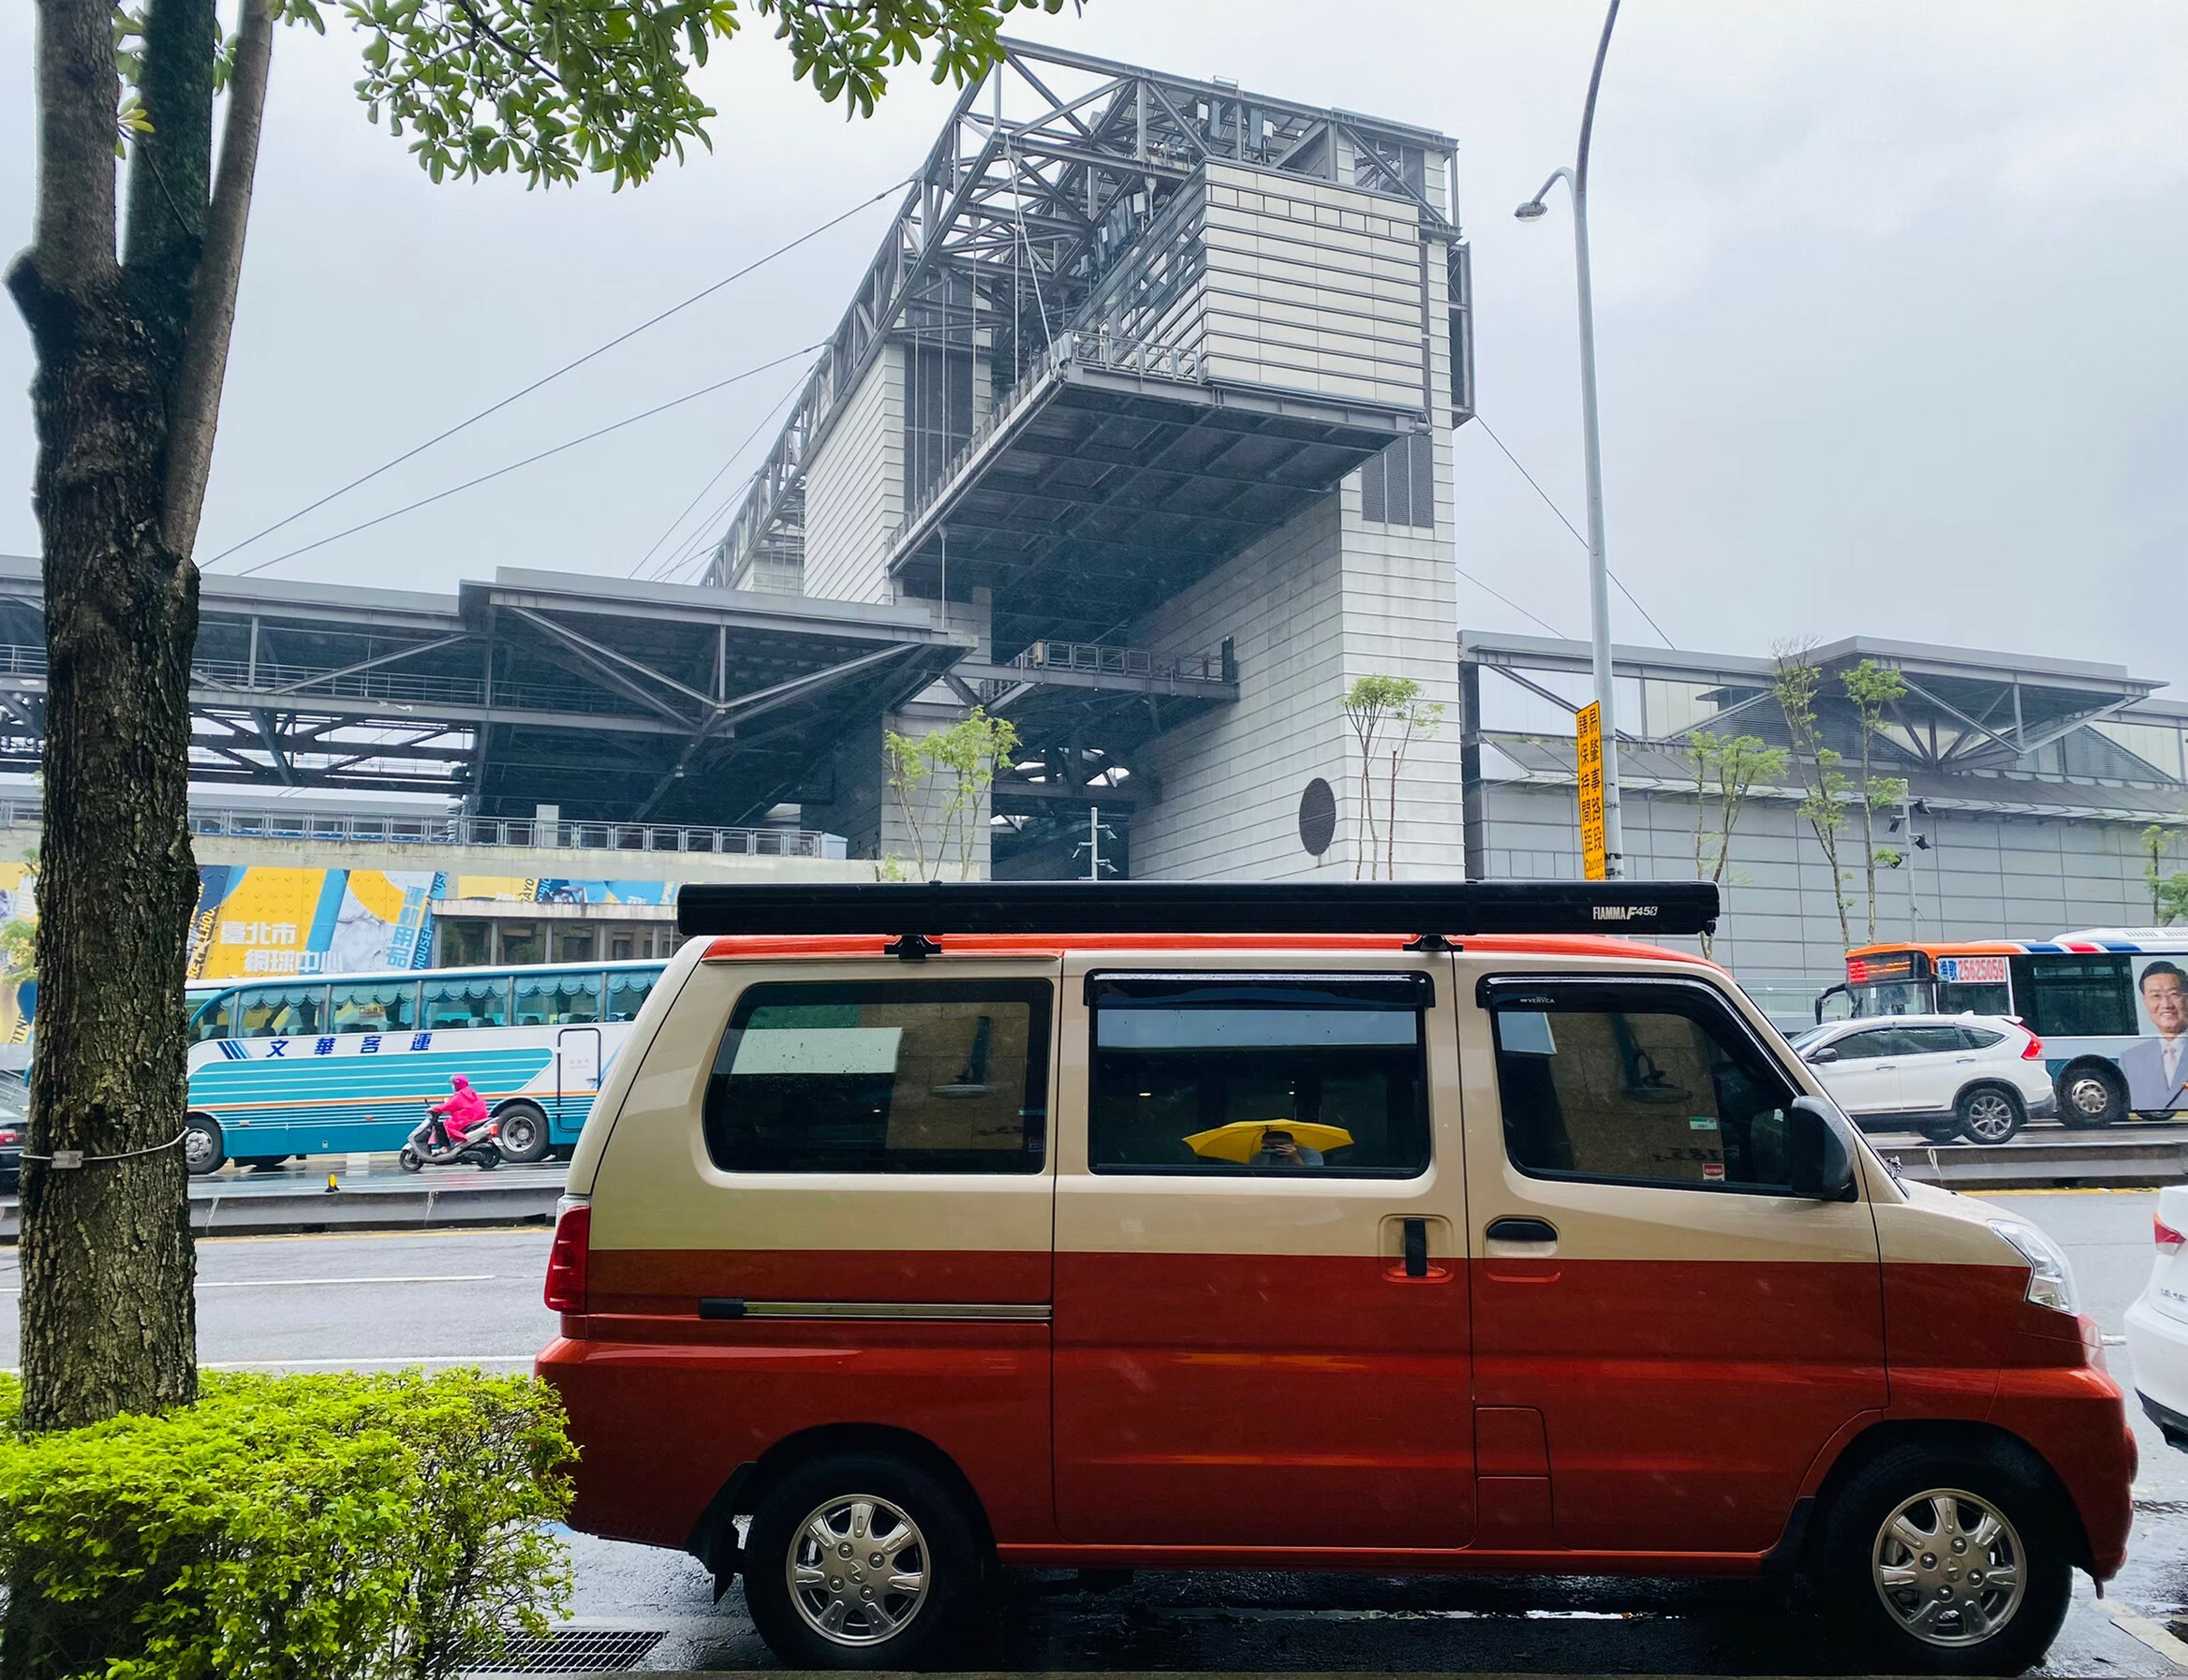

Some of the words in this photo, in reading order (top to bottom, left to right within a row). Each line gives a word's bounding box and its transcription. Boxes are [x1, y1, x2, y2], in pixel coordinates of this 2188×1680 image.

[1579, 715, 1592, 853] 請保持間距
[1589, 708, 1603, 851] 易肇事路段
[1593, 906, 1625, 920] FIAMMA
[220, 921, 297, 945] 臺北市
[244, 949, 344, 973] 網球中心
[1958, 959, 2004, 980] 25625059
[266, 1033, 433, 1058] 文華客運
